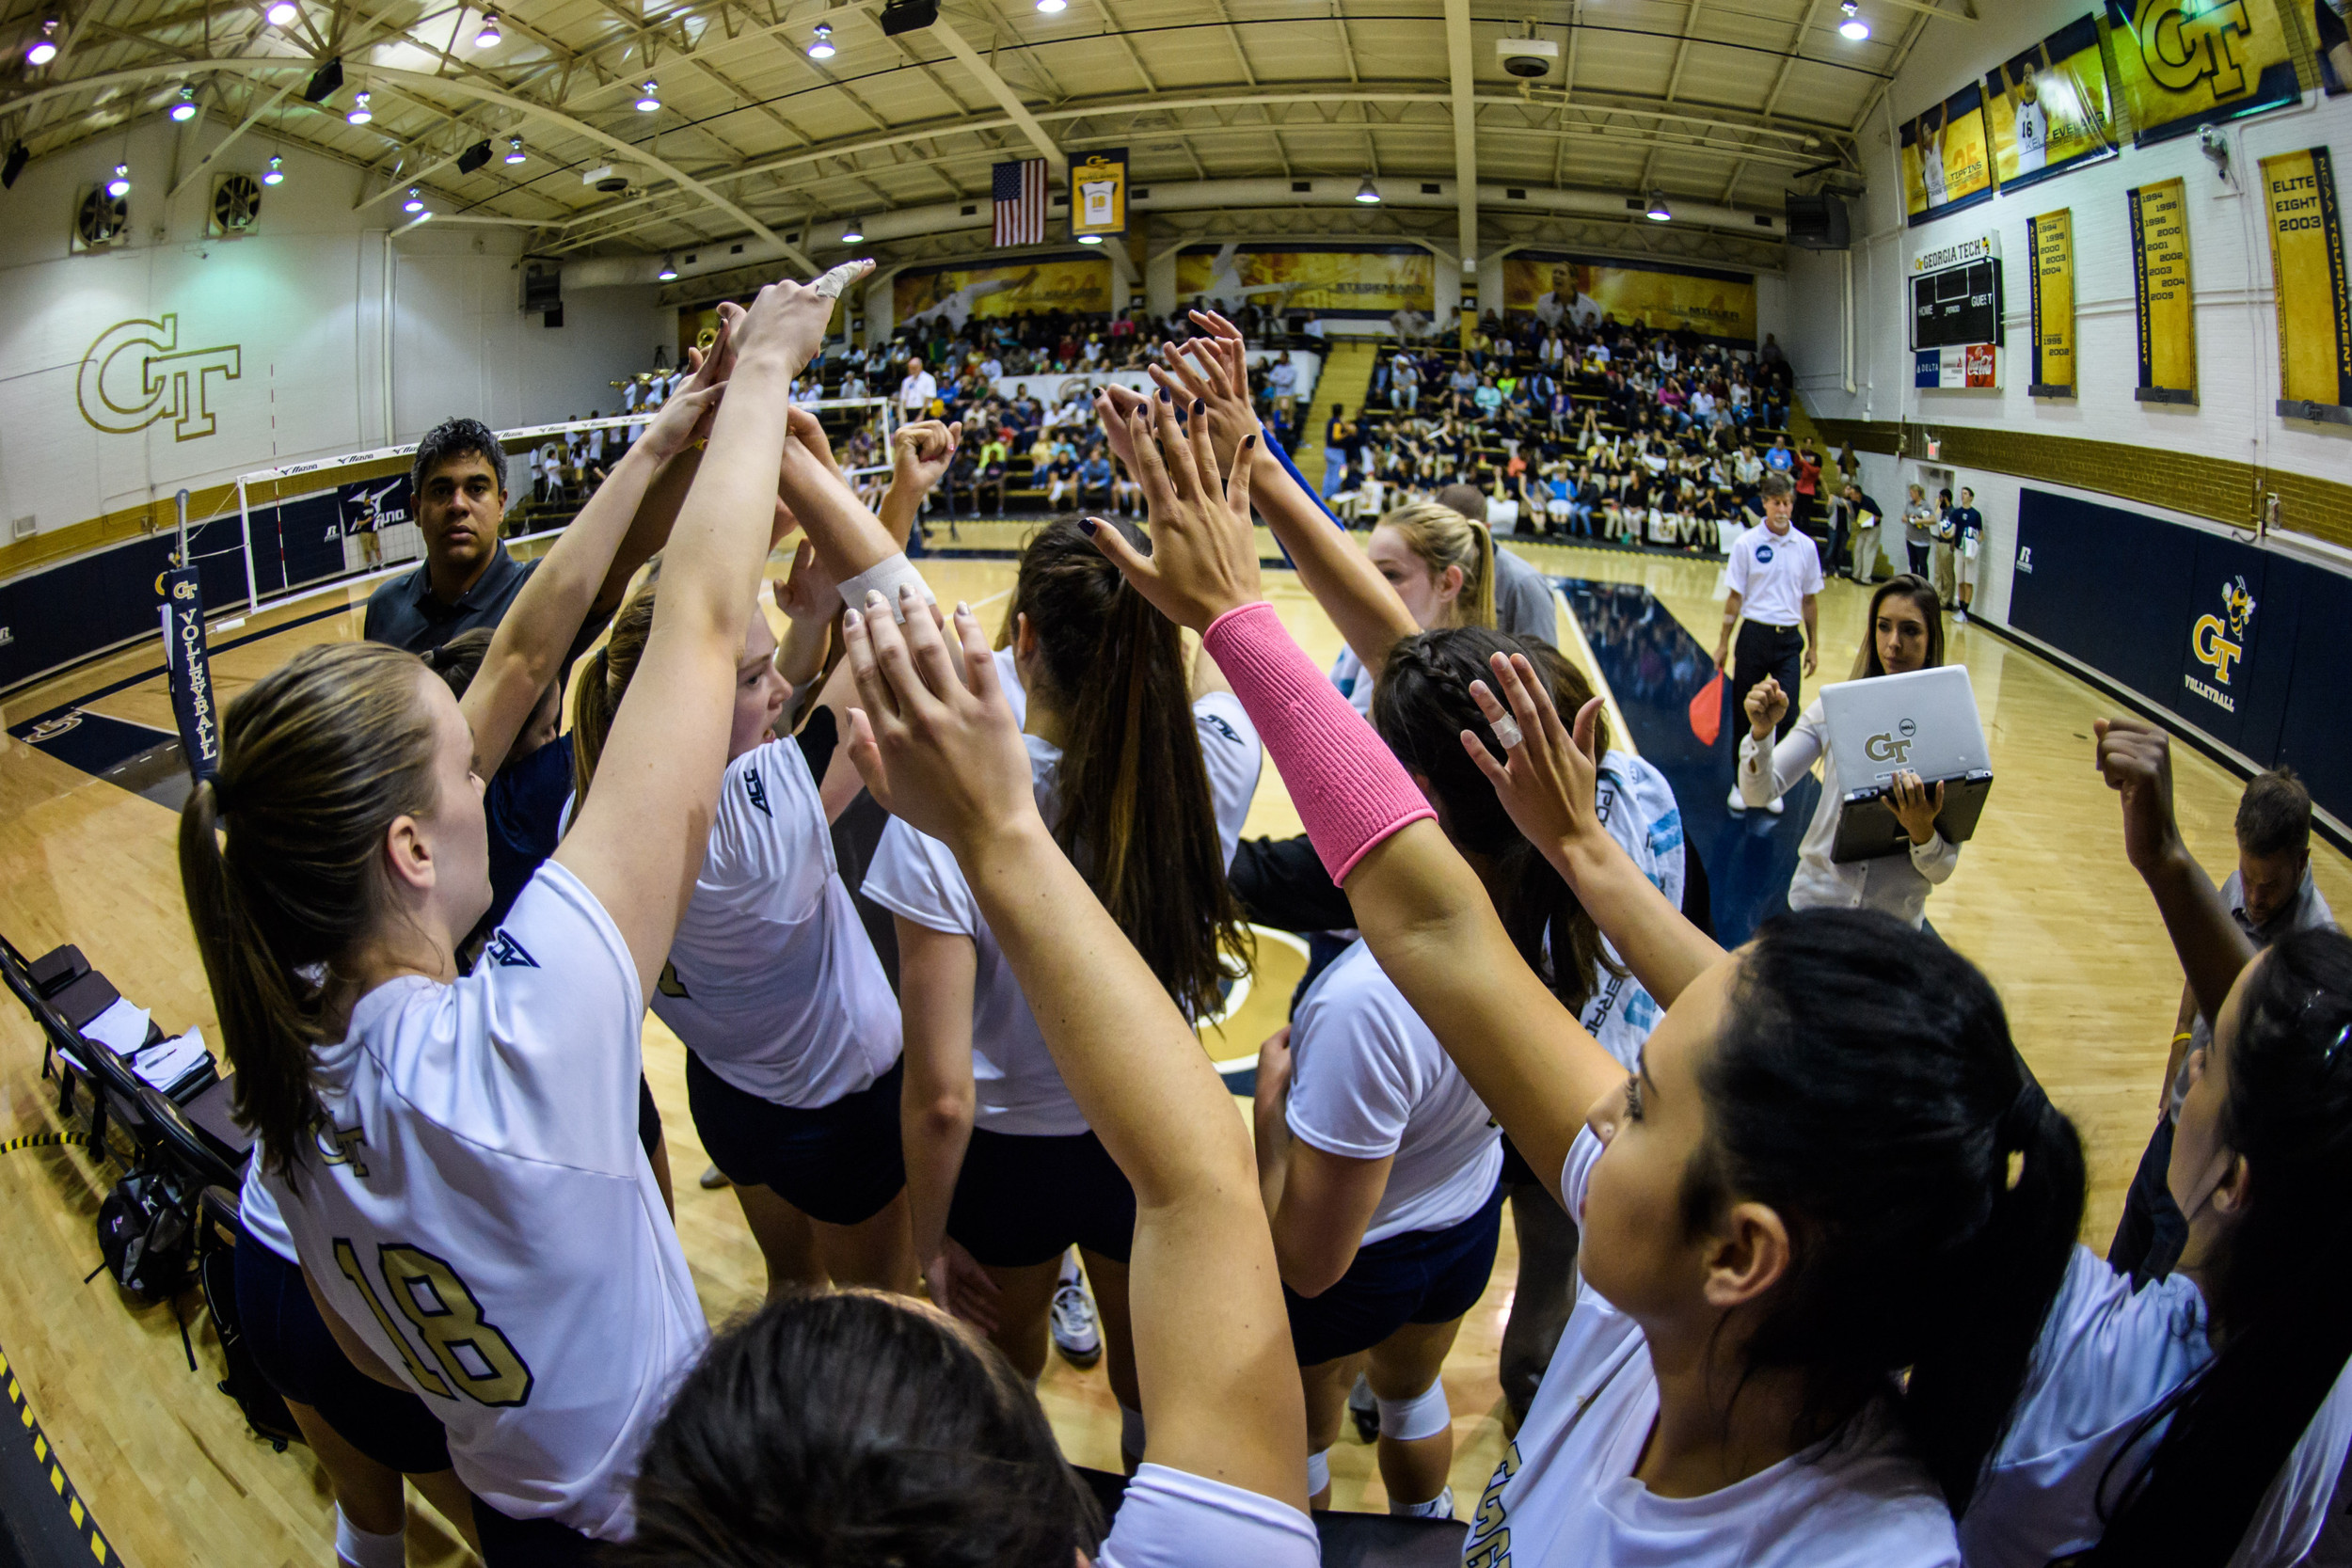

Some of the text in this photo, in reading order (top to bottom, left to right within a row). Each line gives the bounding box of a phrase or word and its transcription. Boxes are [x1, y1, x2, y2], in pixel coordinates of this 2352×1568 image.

[2140, 0, 2251, 101] GT
[2022, 120, 2033, 138] 16
[2272, 175, 2315, 194] ELITE
[2142, 192, 2163, 203] 1994
[2276, 196, 2317, 213] EIGHT
[2156, 200, 2177, 213] 1995
[2145, 216, 2167, 227] 1996
[2279, 215, 2321, 232] 2003
[2156, 227, 2181, 237] 2000
[1923, 246, 1958, 270] GEORGIA
[1958, 239, 1981, 261] TECH
[2040, 245, 2060, 255] 2000
[2147, 241, 2169, 251] 2001
[2045, 254, 2066, 264] 2003
[2159, 252, 2183, 262] 2002
[2041, 266, 2061, 276] 2004
[2149, 266, 2172, 277] 2003
[2319, 157, 2351, 376] NCAA TOURNAMENT
[2132, 197, 2148, 366] NCAA TOURNAMENT
[2161, 277, 2185, 288] 2004
[2150, 292, 2174, 301] 2009
[1921, 362, 1939, 373] DELTA
[77, 313, 241, 443] GT
[173, 580, 198, 599] GT
[2193, 614, 2243, 686] GT
[179, 608, 216, 760] VOLLEYBALL
[2185, 673, 2235, 713] VOLLEYBALL
[1865, 732, 1913, 764] GT
[331, 1236, 534, 1408] 18
